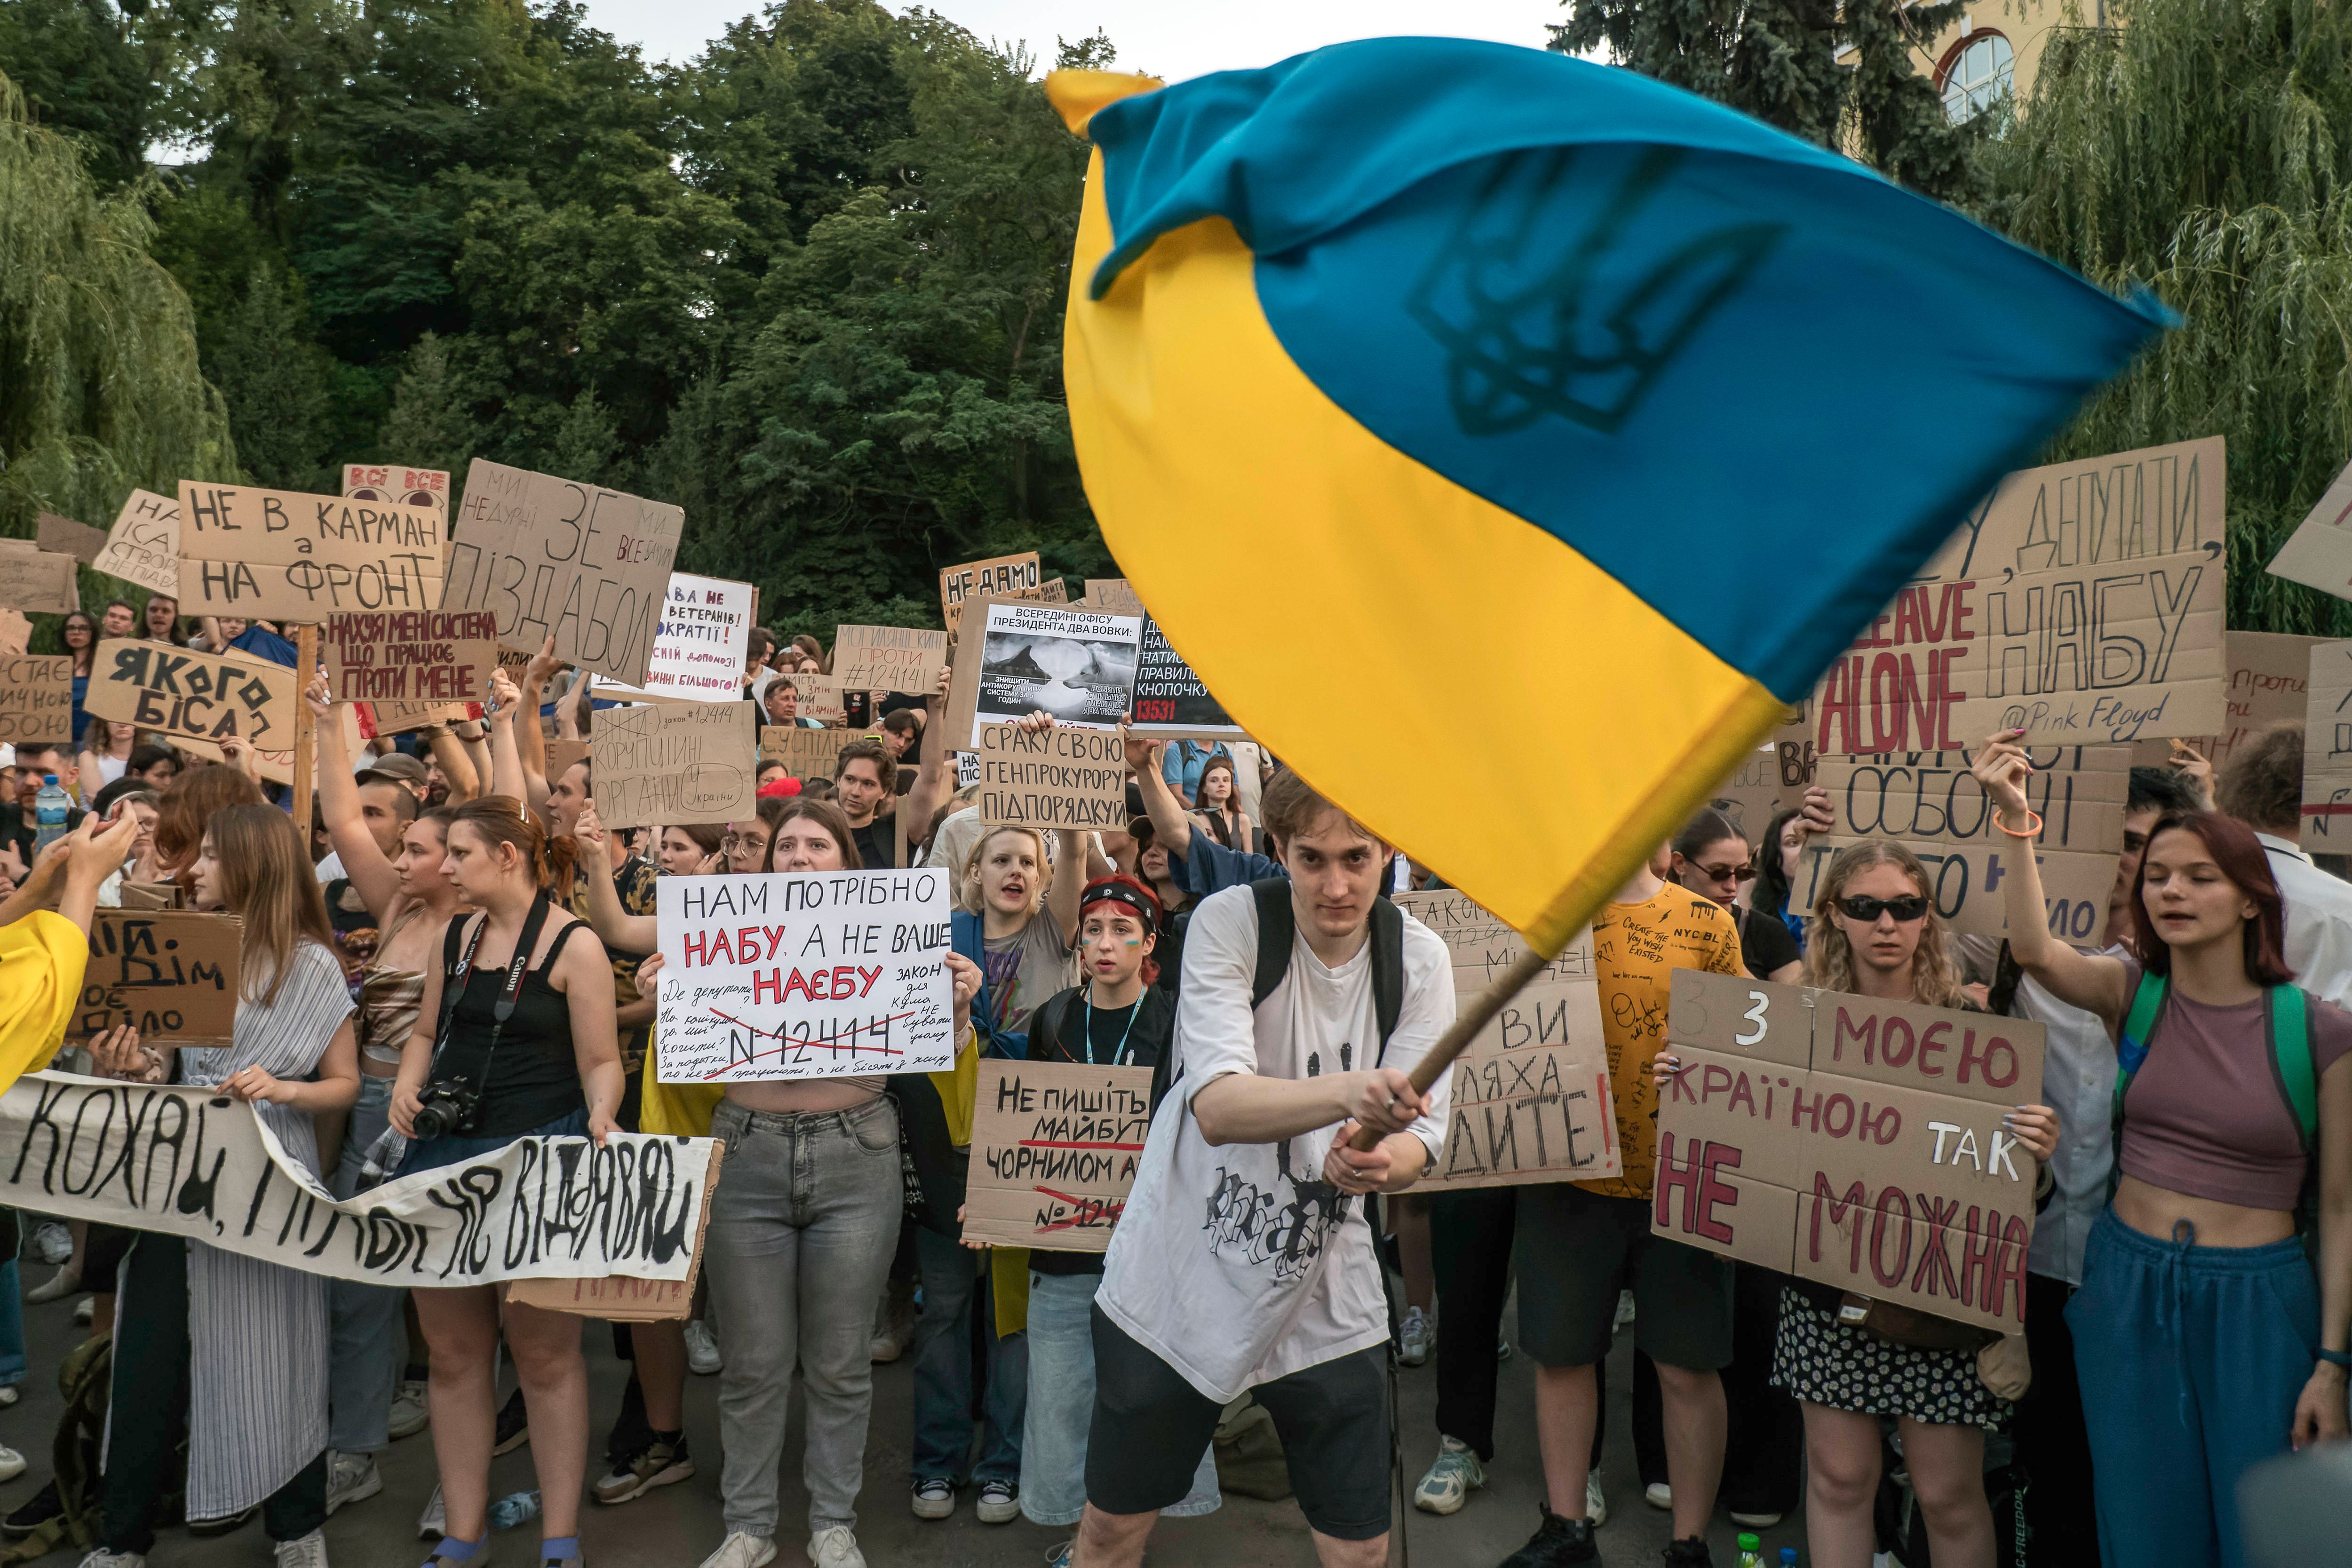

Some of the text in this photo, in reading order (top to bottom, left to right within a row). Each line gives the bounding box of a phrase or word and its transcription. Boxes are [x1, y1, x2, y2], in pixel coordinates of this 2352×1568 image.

[404, 470, 446, 491] ВСЕ
[487, 471, 521, 495] МИ
[190, 488, 437, 547] НЕ В КАРМАН
[463, 493, 490, 520] НЕ
[2017, 453, 2222, 572] ДЕПУТАТИ,
[546, 483, 618, 570] ЗЕ
[636, 508, 667, 534] МИ
[111, 542, 178, 575] СТВОР
[617, 534, 644, 563] ВСЕ
[202, 553, 435, 610] НА ФРОНТ
[946, 560, 1039, 605] НЕ ДАМО
[706, 590, 723, 605] НЕ
[329, 613, 386, 645] НАХУЯ
[431, 611, 498, 641] СИСТЕМА
[669, 606, 741, 627] ВЕТЕРАНІВ!
[994, 617, 1132, 637] ПРЕЗИДЕНТА ДВА ВОВКИ:
[1016, 609, 1113, 625] ВСЕРЕДИНІ ОФІСУ
[1986, 566, 2203, 698] НАБУ
[341, 643, 455, 667] ЩО ПРАЦЮЄ
[859, 647, 922, 666] ПРОТИ
[109, 647, 272, 711] ЯКОГО
[342, 665, 477, 699] ПРОТИ МЕНЕ
[679, 674, 738, 692] БІЛЬШОГО!
[776, 675, 817, 685] МІСТЬ
[1091, 685, 1122, 694] РОБИТИ
[1137, 683, 1208, 697] КНОПОЧКУ
[1136, 700, 1175, 721] 13531
[1818, 647, 1968, 754] ALONE
[664, 717, 686, 729] закон
[688, 705, 733, 724] #12414
[2088, 691, 2170, 743] Floyd
[984, 727, 1122, 762] СРАКУ СВОЮ
[986, 761, 1122, 792] ГЕНПРОКУРОРУ
[596, 776, 678, 820] ОРГАНИ
[984, 791, 1127, 827] ПІДПОРЯДКУЙ
[683, 874, 935, 919] НАМ ПОТРІБНО
[1399, 898, 1498, 926] ТАКОМ
[1622, 916, 1669, 942] CREATE THE
[1674, 928, 1700, 939] NYC
[684, 923, 952, 968] НАБУ, А НЕ ВАШЕ
[1629, 944, 1664, 963] EXISTED
[1644, 938, 1664, 952] WISH
[507, 957, 525, 991] Canon
[753, 965, 883, 1005] НАЄБУ
[896, 962, 942, 981] ЗАКОН
[84, 984, 128, 1009] ОЄ
[662, 979, 685, 1002] Де
[691, 985, 753, 1007] депутати
[904, 982, 928, 1000] для
[660, 1007, 678, 1024] На
[921, 1005, 939, 1014] НЕ
[660, 1028, 677, 1044] за
[903, 1015, 952, 1033] бувати
[1501, 998, 1568, 1049] ВИ
[661, 1037, 726, 1054] кошти?
[910, 1031, 948, 1045] цьому
[1734, 990, 1770, 1046] З
[1832, 1006, 2020, 1089] МОЄЮ
[660, 1056, 729, 1070] За податки,
[912, 1055, 950, 1066] жиру
[1451, 1053, 1562, 1103] ЛЯХА
[1421, 1073, 1613, 1181] ДИТЕ!
[1672, 1063, 2022, 1183] КРАЇНОЮ ТАК
[987, 1146, 1113, 1183] ЧОРНИЛОМ
[1656, 1131, 2029, 1323] НЕ МОЖНА
